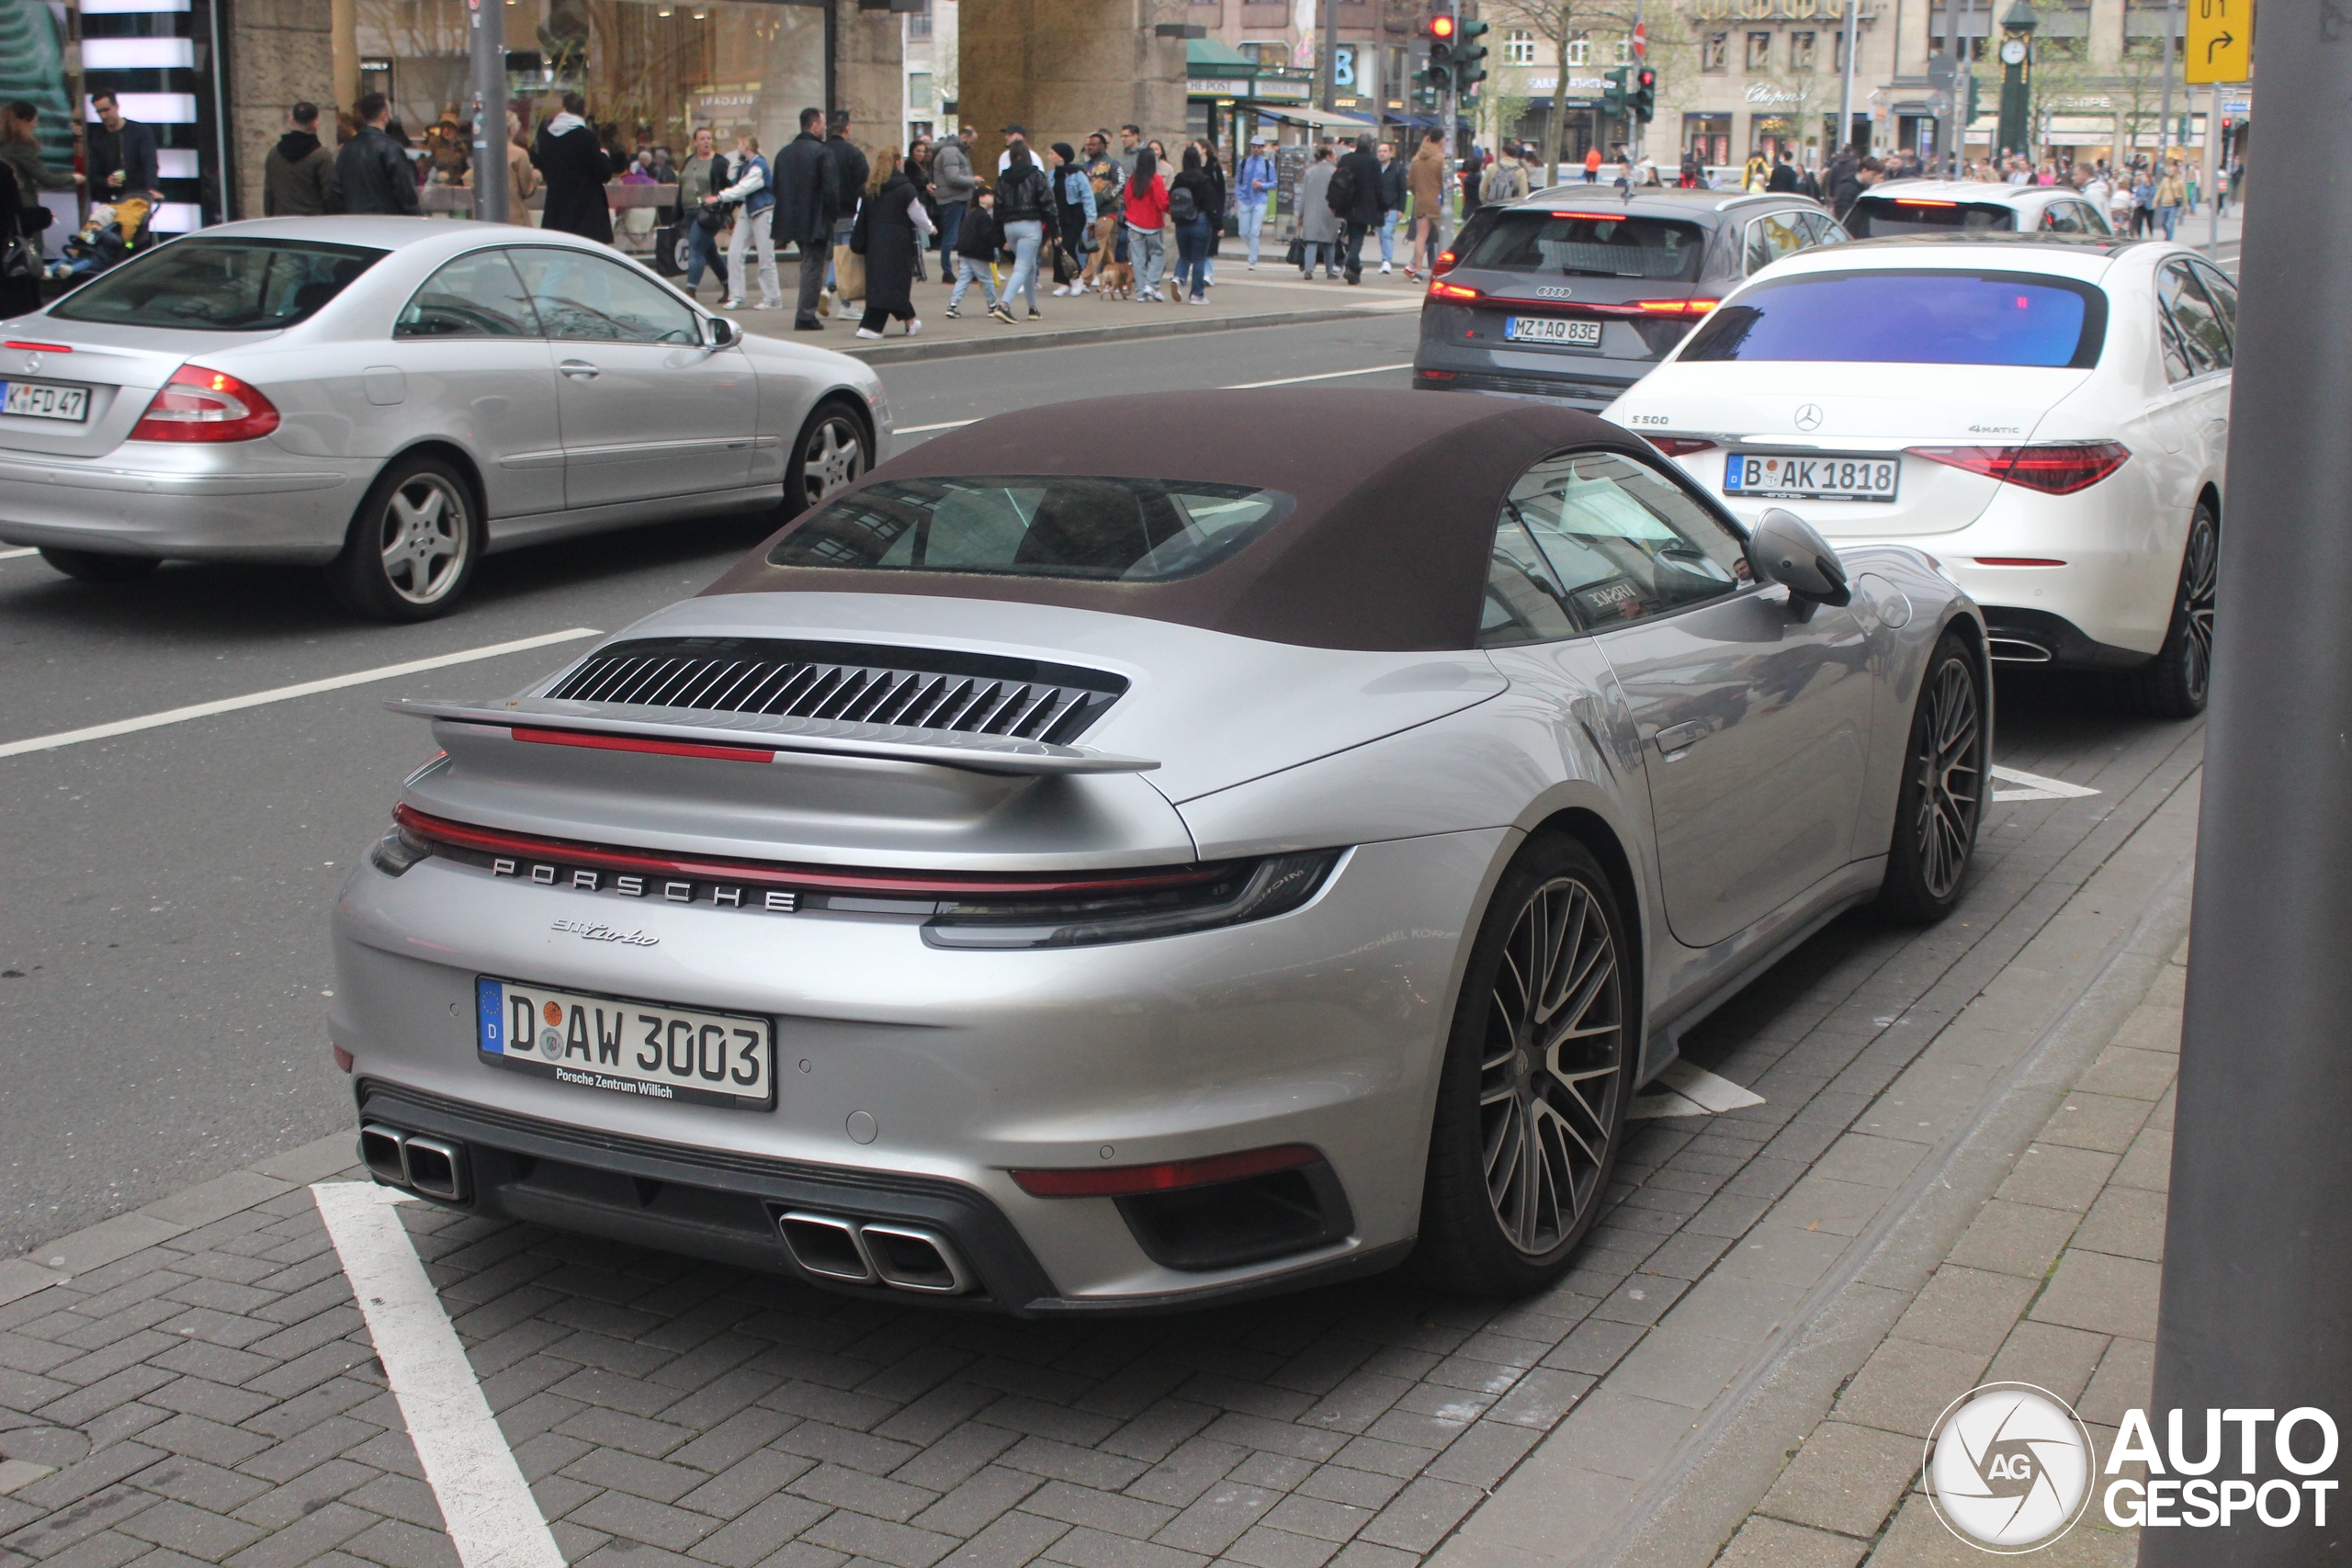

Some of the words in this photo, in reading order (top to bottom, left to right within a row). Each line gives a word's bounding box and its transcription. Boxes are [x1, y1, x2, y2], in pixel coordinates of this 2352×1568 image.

[1335, 49, 1354, 85] B
[1206, 81, 1231, 91] POST
[1514, 320, 1535, 336] MZ
[1544, 321, 1566, 337] AQ
[1568, 323, 1599, 340] 83E
[7, 387, 20, 409] K
[30, 389, 55, 412] FD
[59, 390, 82, 415] 47
[1631, 415, 1641, 423] S
[1642, 415, 1669, 424] 500
[1968, 424, 2020, 434] 4MATIC
[1731, 475, 1738, 484] D
[1745, 459, 1761, 486] B
[1781, 461, 1817, 489] AK
[1822, 462, 1892, 491] 1818
[493, 858, 797, 913] PORSCHE
[582, 923, 660, 946] turbo
[488, 1023, 496, 1039] D
[510, 994, 535, 1052] D
[564, 1004, 623, 1066] AW
[637, 1014, 760, 1087] 3003
[556, 1067, 594, 1086] Porsche
[595, 1075, 637, 1093] Zentrum
[638, 1081, 673, 1099] Willich
